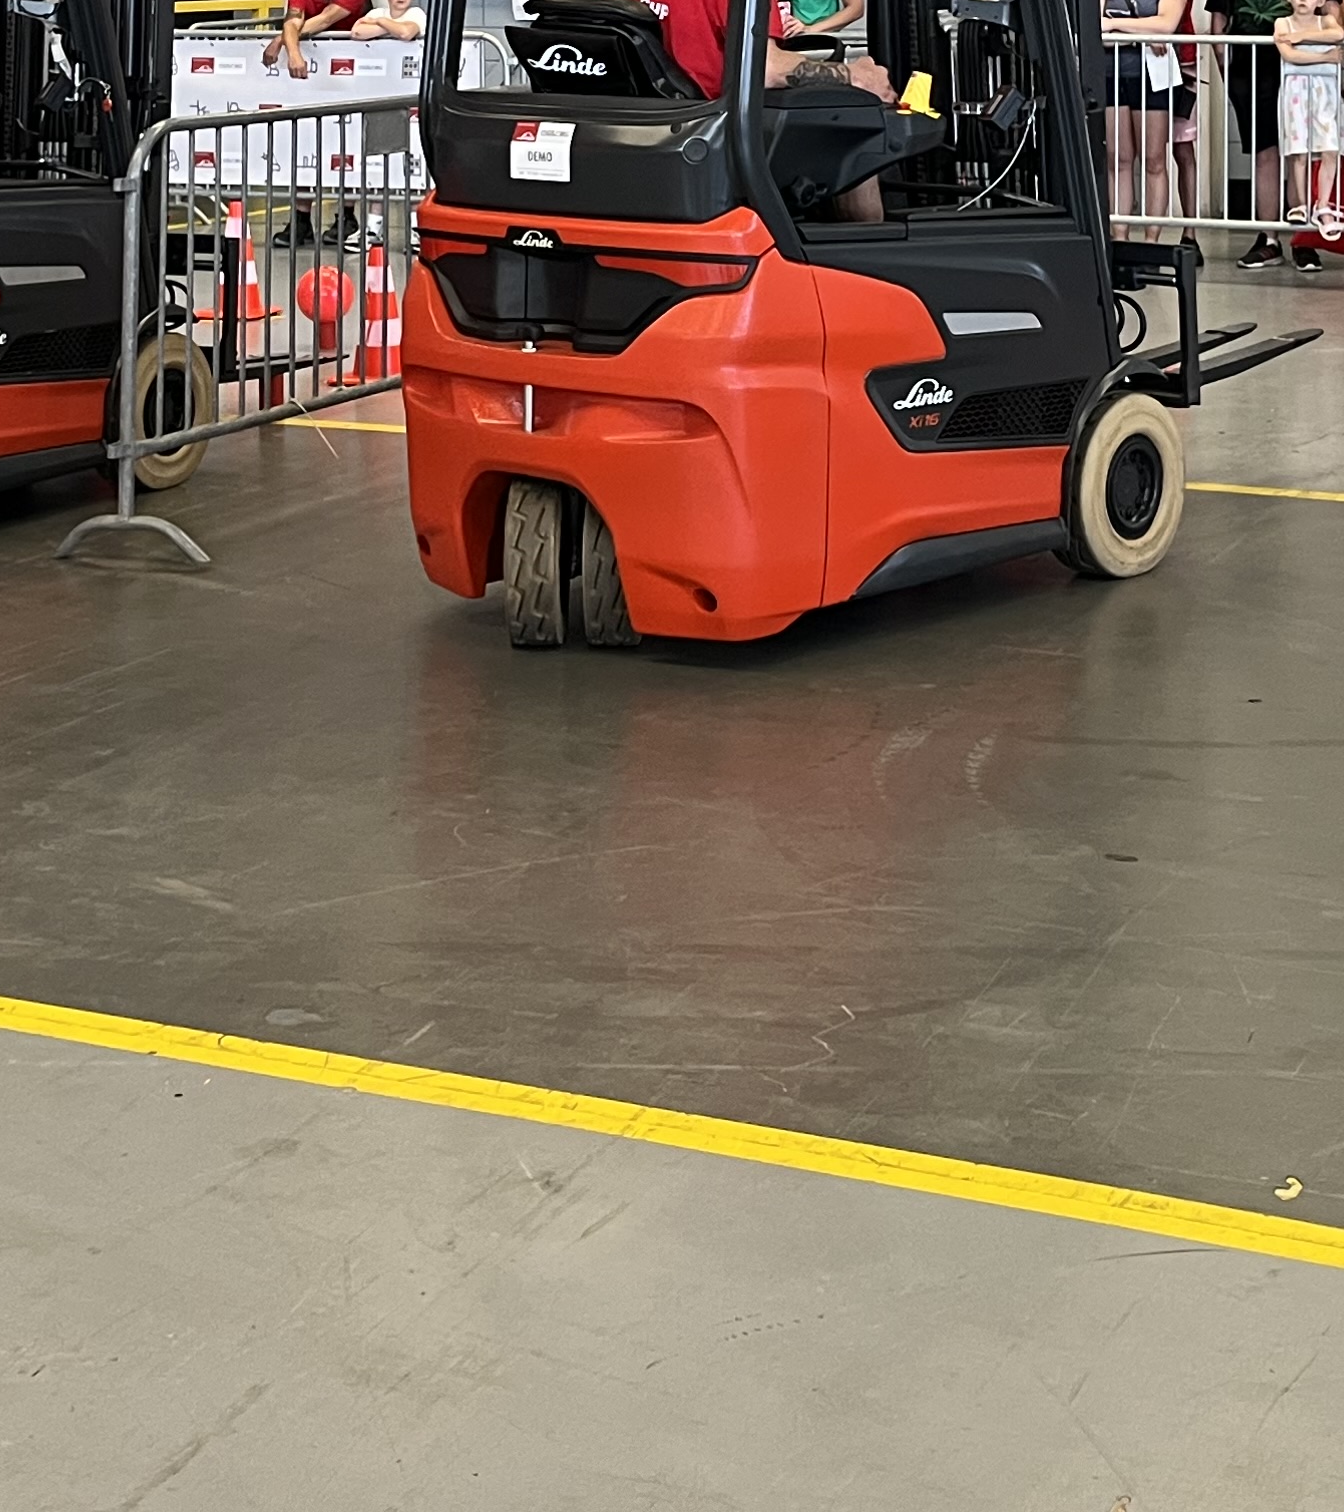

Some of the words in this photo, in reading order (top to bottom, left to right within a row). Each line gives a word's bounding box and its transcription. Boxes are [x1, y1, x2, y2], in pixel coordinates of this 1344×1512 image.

[527, 43, 608, 76] Linde
[527, 151, 553, 162] DEMO
[513, 230, 554, 248] Linde
[893, 378, 954, 410] Linde
